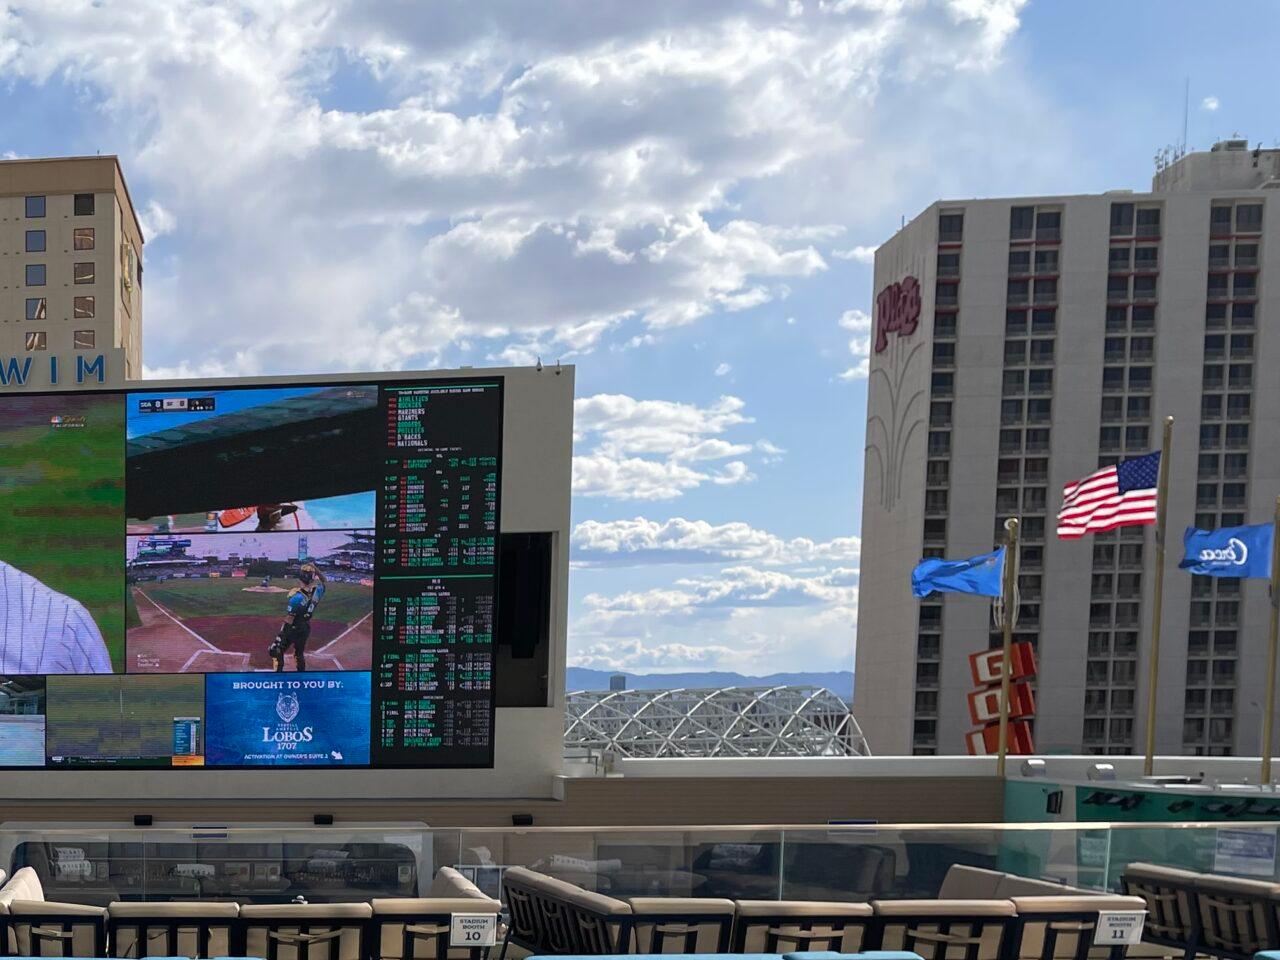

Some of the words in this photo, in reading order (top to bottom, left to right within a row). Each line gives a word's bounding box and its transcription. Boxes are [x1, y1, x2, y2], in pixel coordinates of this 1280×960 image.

[287, 681, 300, 689] TO
[262, 727, 313, 742] LOBOS
[465, 932, 481, 941] 10
[1112, 930, 1124, 938] 11
